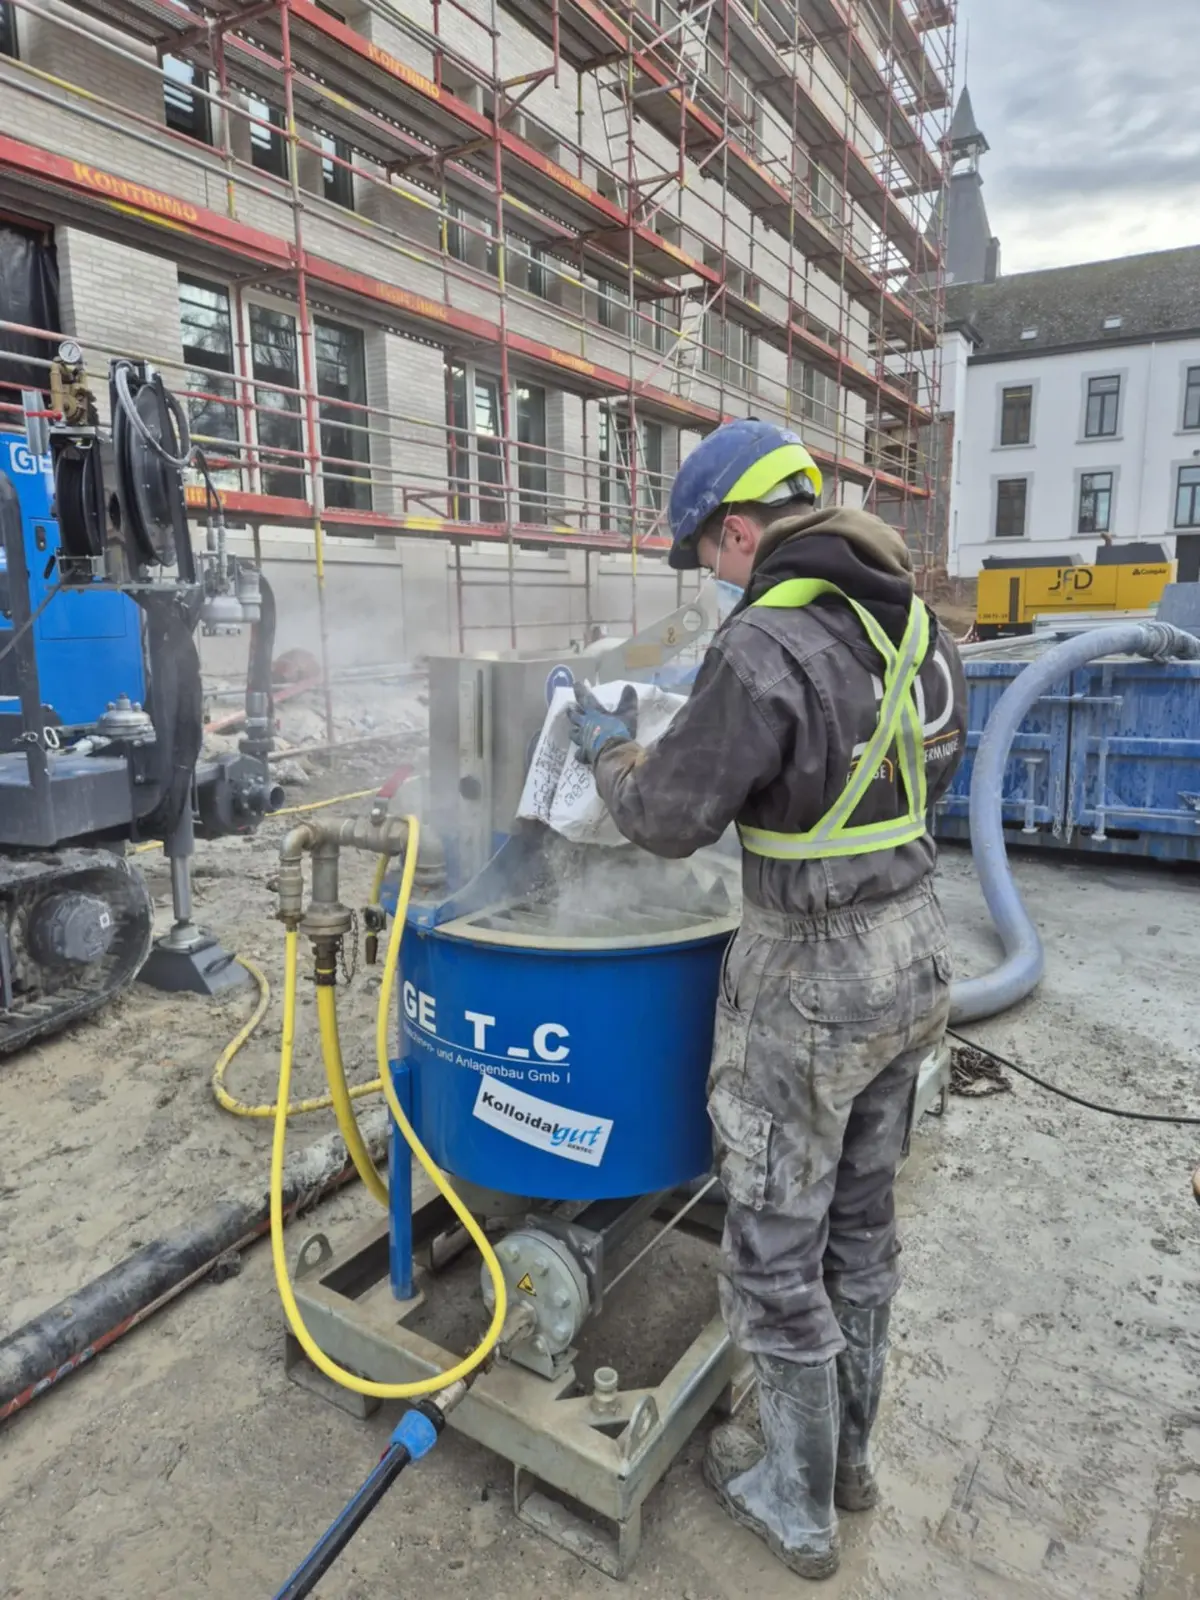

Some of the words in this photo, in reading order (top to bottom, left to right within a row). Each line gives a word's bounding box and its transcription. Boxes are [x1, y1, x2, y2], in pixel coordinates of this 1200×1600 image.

[1048, 568, 1093, 590] JFD
[437, 1048, 454, 1063] und
[455, 1054, 524, 1080] Anlagenbau
